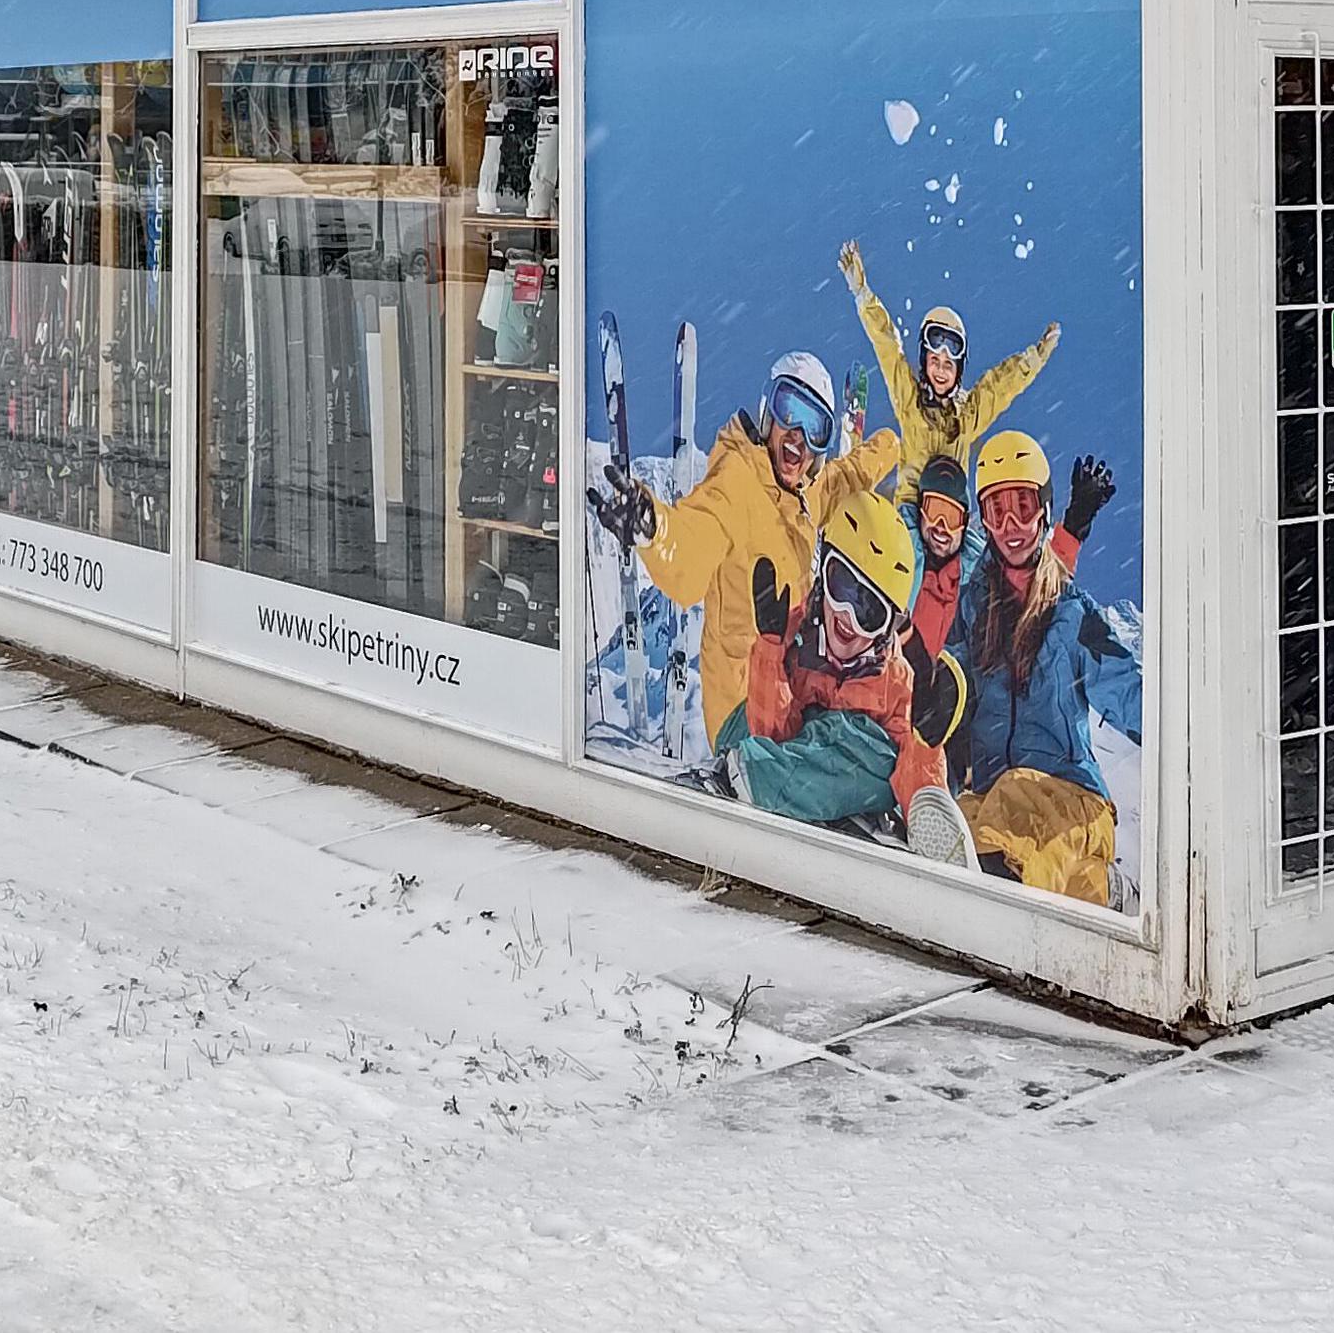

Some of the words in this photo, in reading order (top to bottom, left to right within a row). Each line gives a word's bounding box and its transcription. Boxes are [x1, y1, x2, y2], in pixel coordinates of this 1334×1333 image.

[477, 46, 554, 71] RIDE
[9, 538, 36, 573] 773
[40, 547, 69, 582] 348
[74, 555, 103, 591] 700
[257, 604, 461, 686] www.skipetriny.cz
